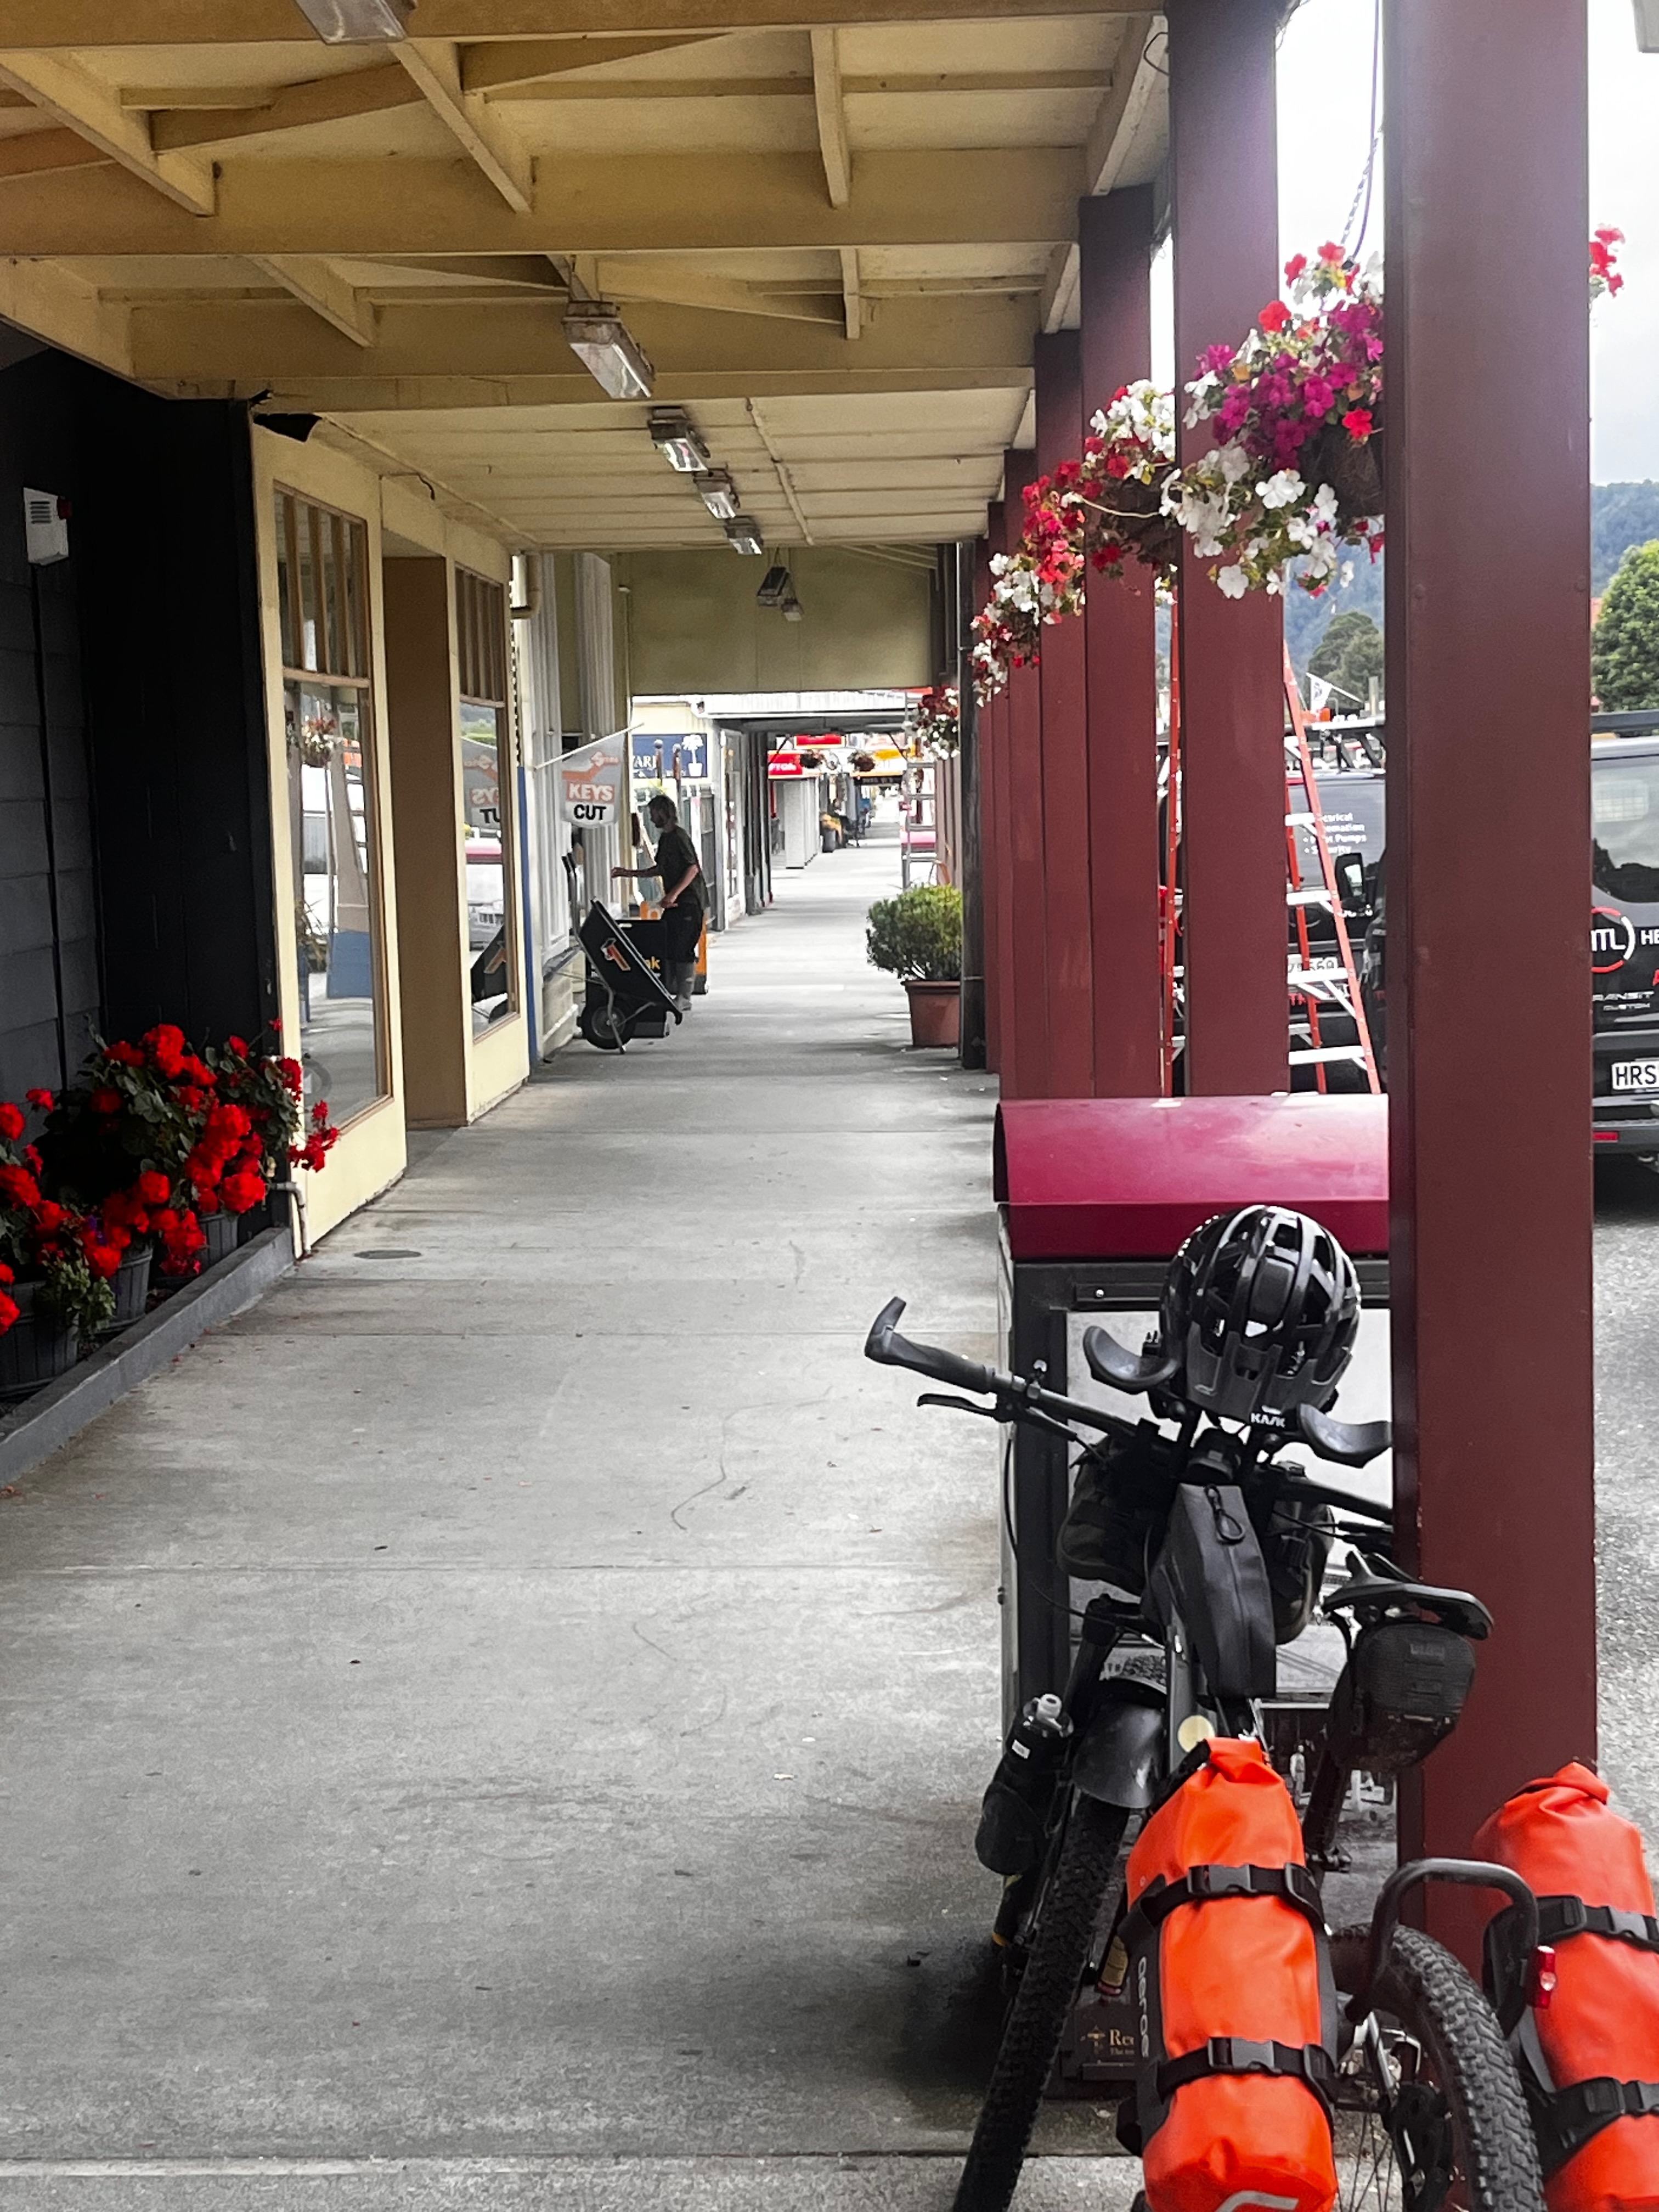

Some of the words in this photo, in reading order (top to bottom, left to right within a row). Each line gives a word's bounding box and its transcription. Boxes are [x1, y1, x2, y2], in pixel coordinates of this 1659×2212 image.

[569, 783, 613, 802] KEYS
[574, 804, 606, 820] CUT
[1592, 990, 1655, 1002] RANSIT
[1616, 1064, 1657, 1086] HRS
[1251, 1412, 1286, 1428] KASK
